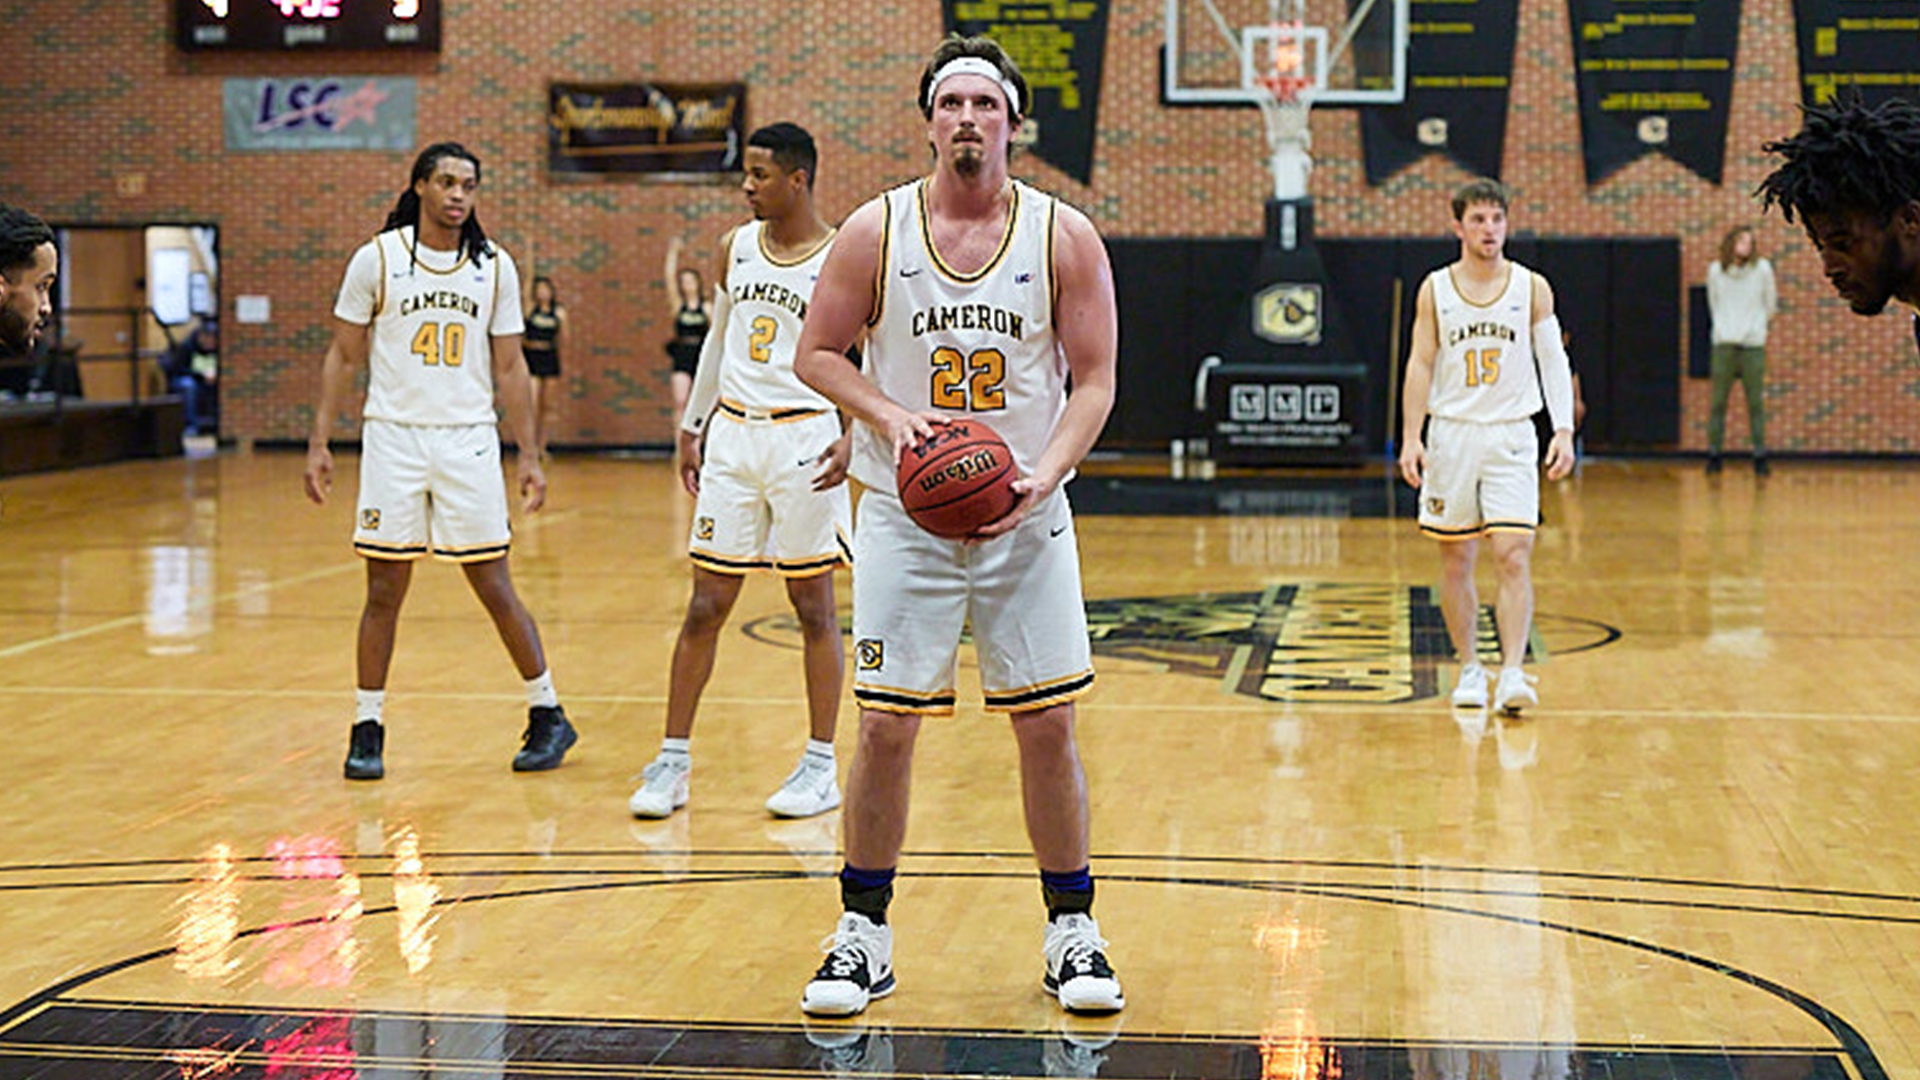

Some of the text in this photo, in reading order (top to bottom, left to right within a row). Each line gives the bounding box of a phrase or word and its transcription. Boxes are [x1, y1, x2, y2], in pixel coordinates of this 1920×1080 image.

[258, 82, 340, 128] LSC
[400, 291, 479, 318] CAMERON
[733, 283, 807, 321] CAMERON
[912, 304, 1024, 341] CAMERON
[411, 321, 466, 367] 40
[749, 315, 779, 364] 2
[1449, 321, 1515, 347] CAMERON
[931, 346, 1006, 411] 22
[1464, 348, 1501, 387] 15
[919, 449, 998, 492] Wilson
